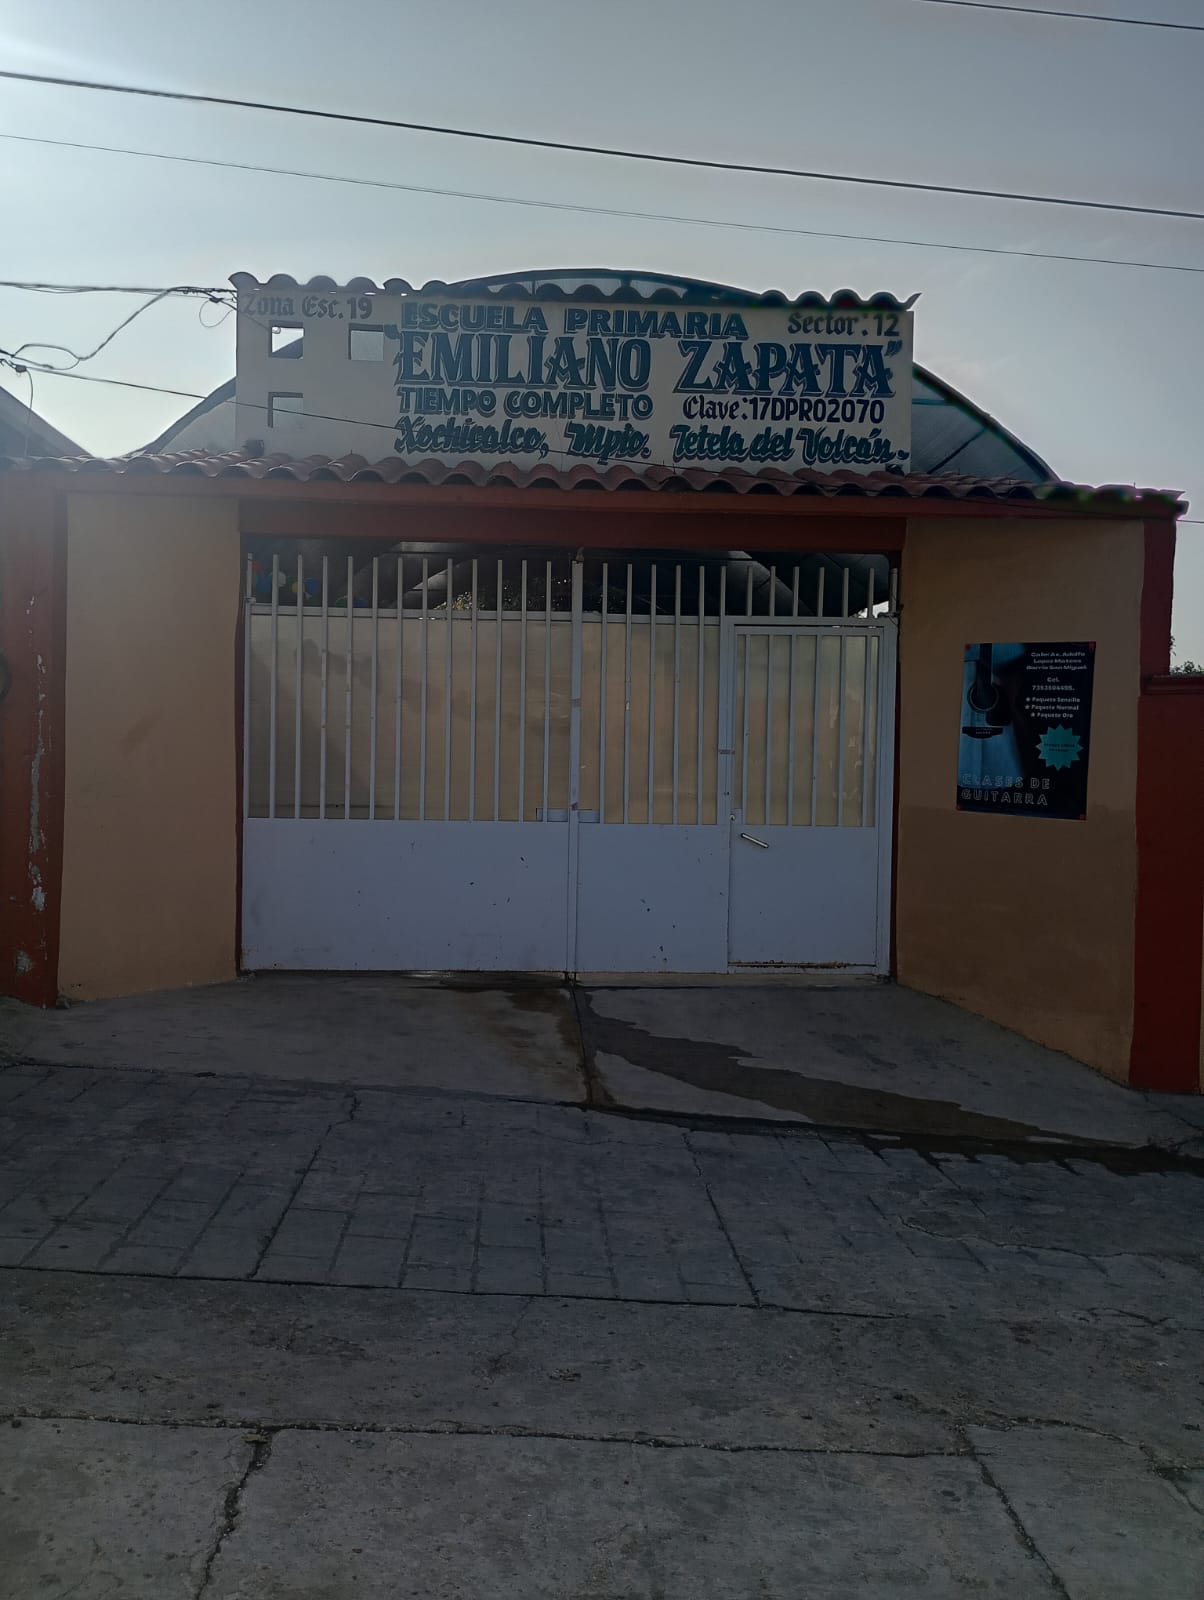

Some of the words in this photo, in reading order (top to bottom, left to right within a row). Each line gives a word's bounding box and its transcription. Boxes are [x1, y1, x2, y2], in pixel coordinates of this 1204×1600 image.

[241, 294, 295, 316] Zona
[302, 295, 344, 319] Esc.
[347, 296, 373, 319] 19
[401, 302, 549, 333] ESCUELA
[565, 308, 749, 340] PRIMARIA
[875, 313, 900, 337] 12
[398, 387, 497, 416] TIEMPO
[503, 388, 653, 421] COMPLETO
[394, 416, 549, 458] Xochicalco,
[671, 424, 747, 463] Tetela
[750, 426, 795, 461] del
[962, 773, 1024, 788] CLASES
[1030, 777, 1051, 790] DE
[961, 788, 1048, 805] GUITARRA
